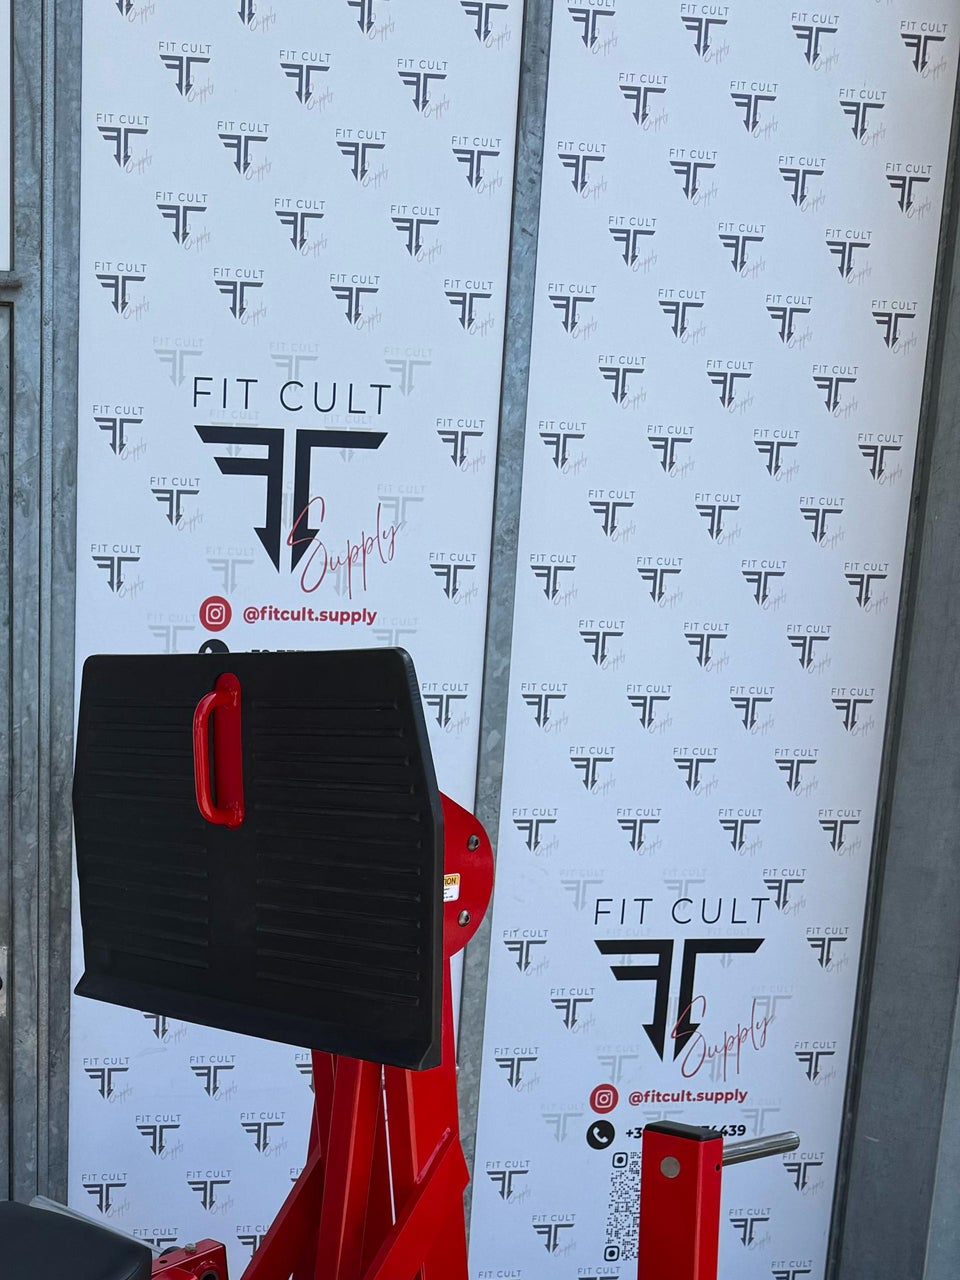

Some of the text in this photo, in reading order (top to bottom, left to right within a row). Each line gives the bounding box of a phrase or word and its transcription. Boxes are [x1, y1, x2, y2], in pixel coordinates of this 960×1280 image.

[680, 3, 730, 17] FIT CULT
[900, 20, 949, 34] FIT CULT
[279, 49, 332, 63] FIT CULT
[96, 112, 150, 126] FIT CULT
[557, 140, 607, 153] FIT CULT
[778, 155, 827, 168] FIT CULT
[213, 267, 265, 279] FIT CULT
[443, 278, 494, 291] FIT CULT
[658, 288, 707, 300] FIT CULT
[871, 299, 919, 311] FIT CULT
[193, 376, 392, 415] FIT CULT
[538, 420, 587, 431] FIT CULT
[753, 428, 801, 440] FIT CULT
[149, 476, 201, 487] FIT CULT
[286, 496, 401, 600] Supply
[428, 552, 477, 563] FIT CULT
[636, 556, 684, 567] FIT CULT
[844, 562, 890, 572] FIT CULT
[243, 607, 378, 627] @fitcult.supply
[421, 682, 469, 692] FIT CULT
[831, 687, 876, 697] FIT CULT
[673, 747, 719, 756] FIT CULT
[512, 807, 559, 817] FIT CULT
[762, 868, 807, 877] FIT CULT
[594, 897, 770, 925] FIT CULT
[502, 927, 549, 938] FIT CULT
[670, 995, 775, 1082] Supply
[494, 1046, 539, 1056] FIT CULT
[189, 1054, 236, 1064] FIT CULT
[629, 1088, 748, 1106] @fitcult.supply
[625, 1126, 643, 1139] +3
[485, 1159, 531, 1169] FIT CULT
[81, 1172, 128, 1182] FIT CULT
[478, 1269, 522, 1279] FIT CULT
